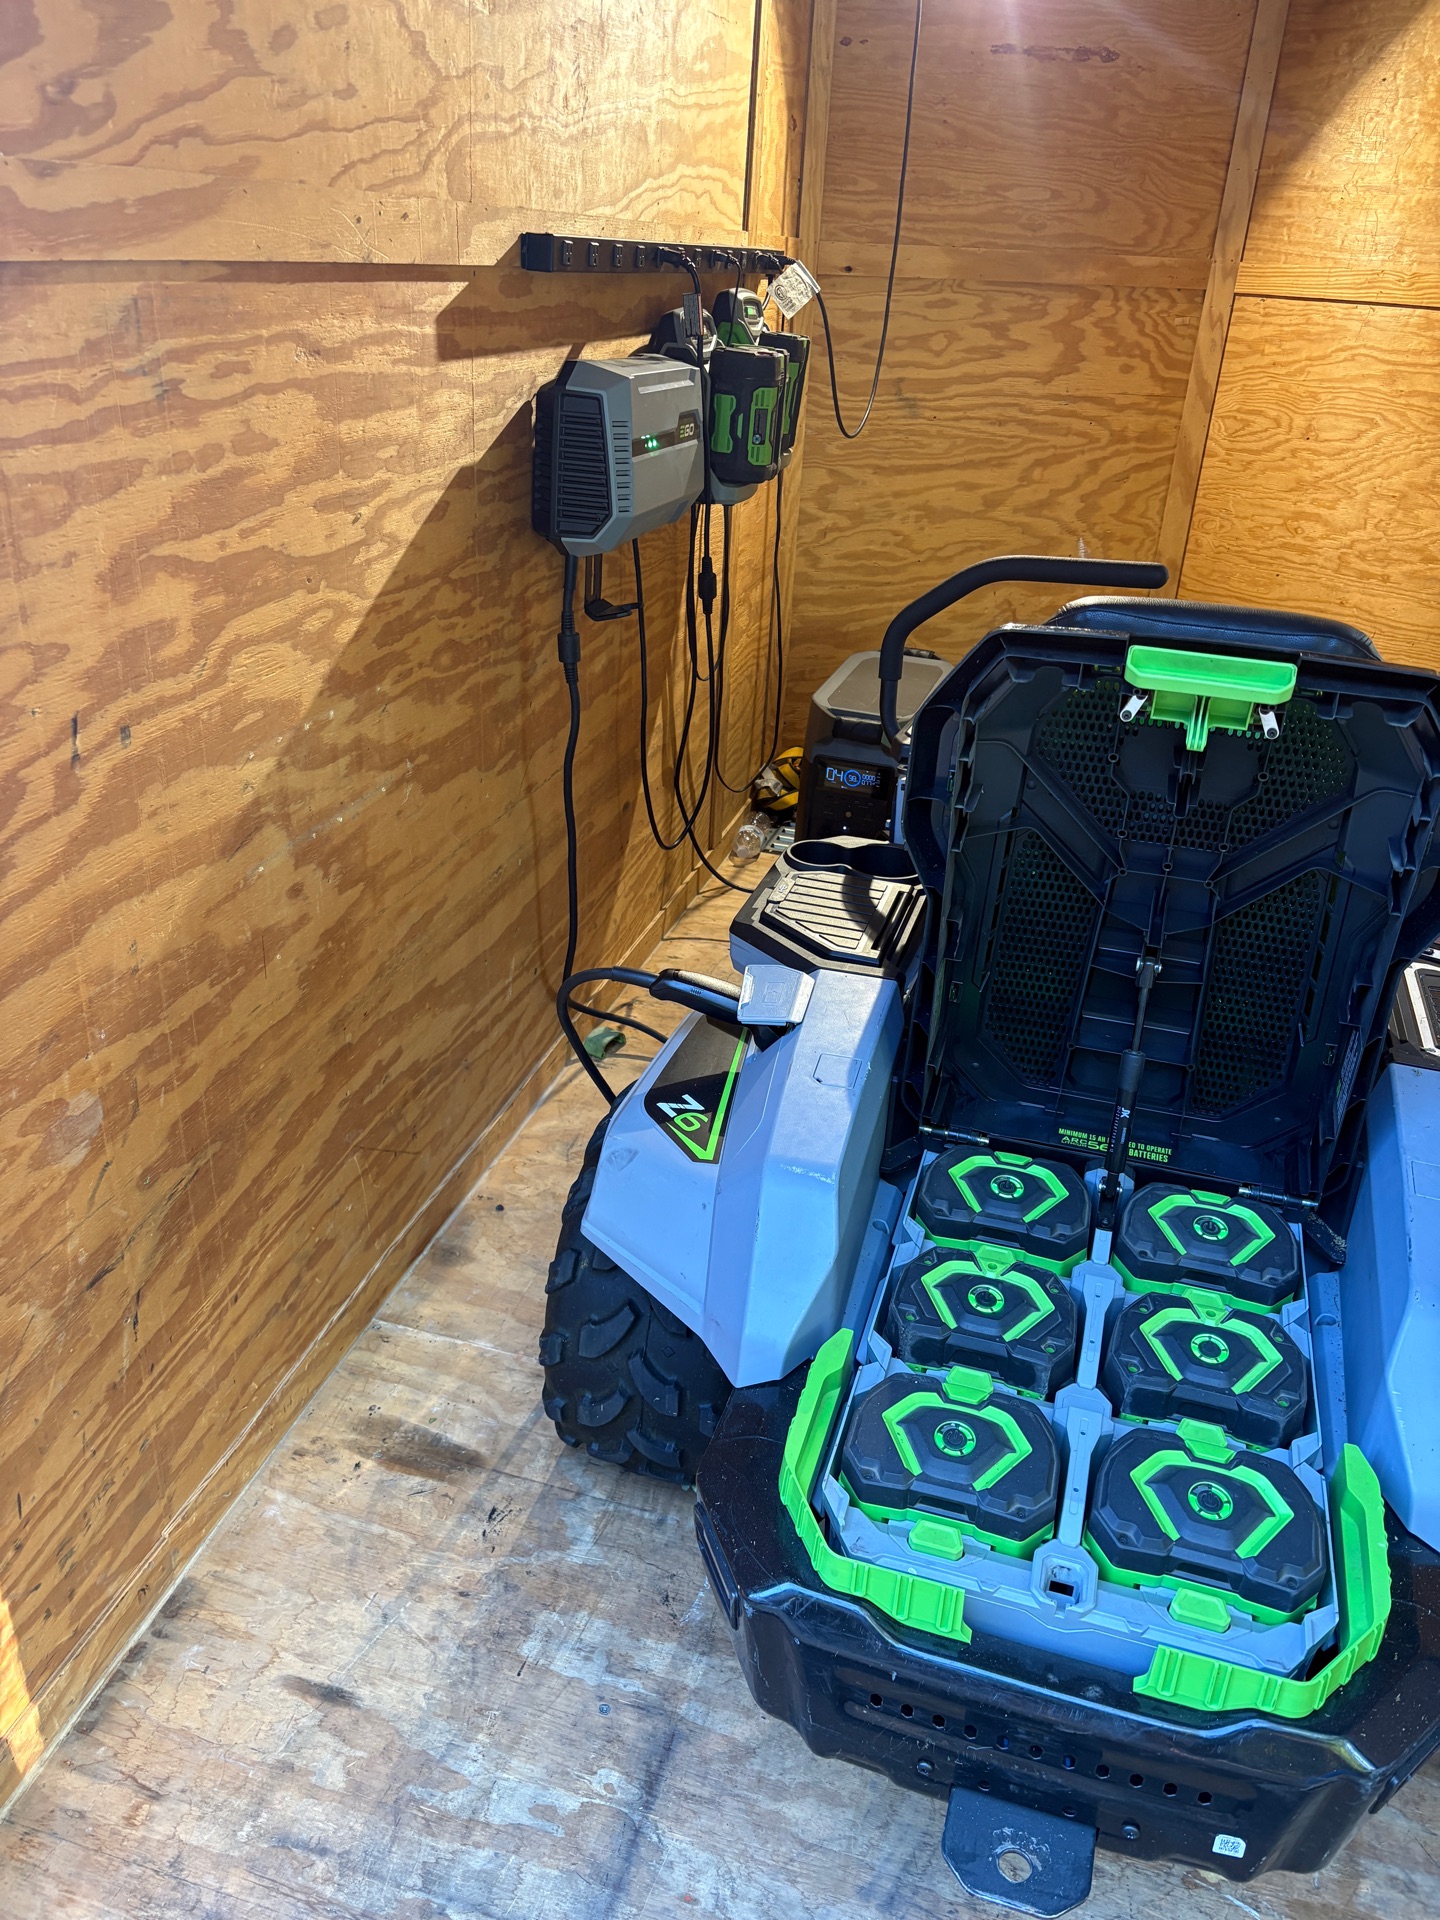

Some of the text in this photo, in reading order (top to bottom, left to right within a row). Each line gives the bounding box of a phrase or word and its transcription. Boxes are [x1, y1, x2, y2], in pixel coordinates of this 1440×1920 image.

[680, 423, 695, 439] EGO
[656, 1094, 709, 1132] Z6
[1058, 1128, 1088, 1139] MINIMUM
[1097, 1135, 1106, 1143] AH
[1137, 1142, 1145, 1150] TO
[1146, 1145, 1172, 1155] OPERATE
[1061, 1136, 1088, 1145] ARC
[1128, 1149, 1169, 1163] BATTERIES
